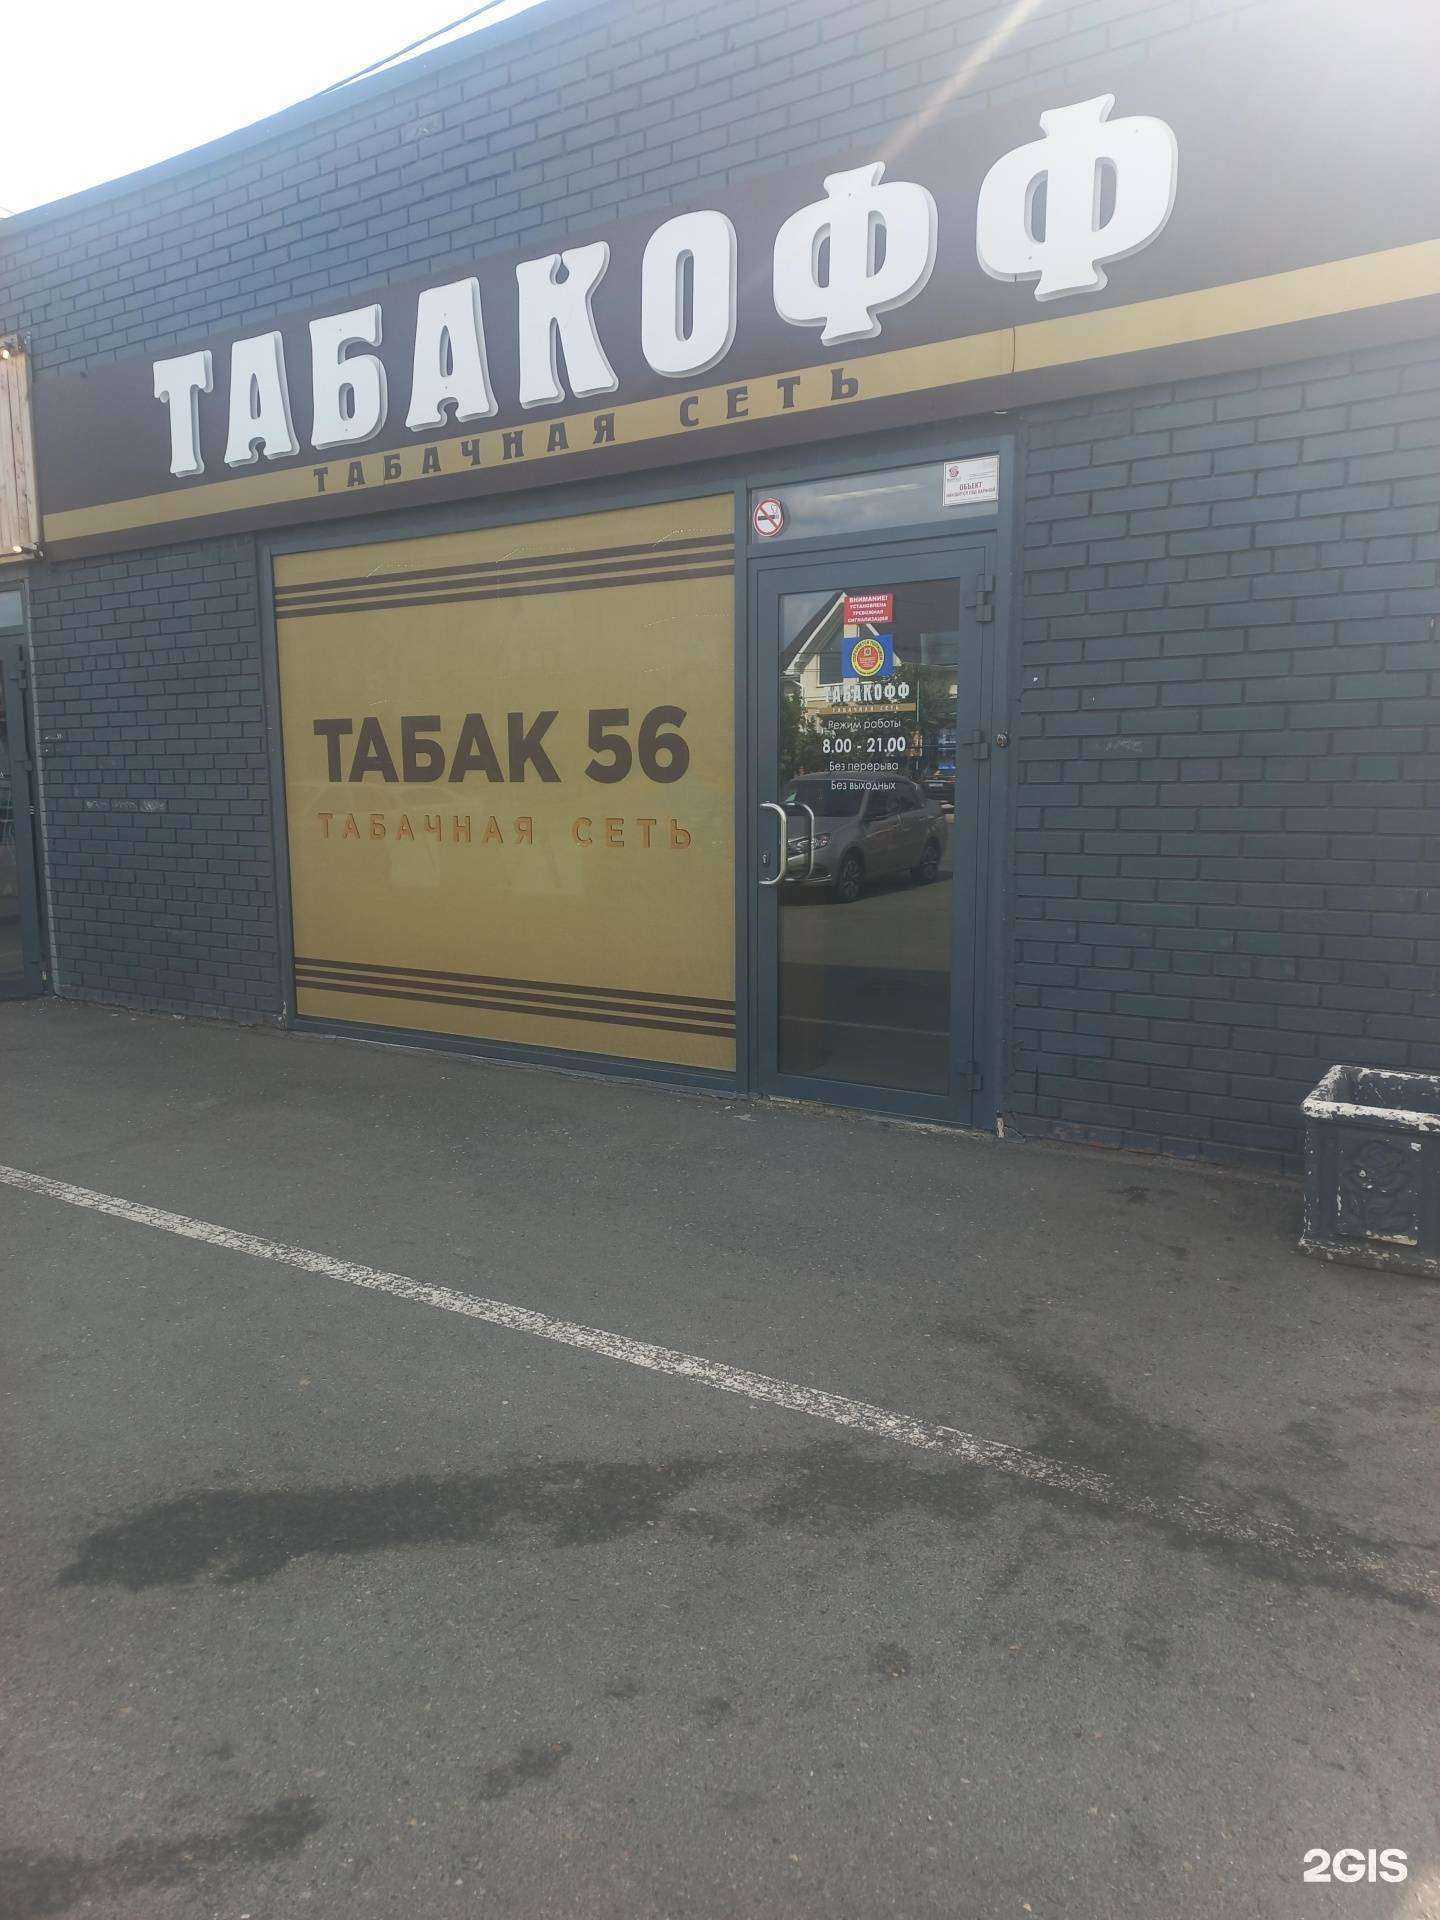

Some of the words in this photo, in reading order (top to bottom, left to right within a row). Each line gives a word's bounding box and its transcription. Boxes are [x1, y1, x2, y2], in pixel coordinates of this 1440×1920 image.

[153, 93, 1178, 478] ТАБАКОФФ
[313, 413, 615, 492] ТАБАЧНАЯ
[679, 368, 859, 428] СЕТЬ
[849, 595, 888, 603] ВНИМАНИЕ!
[825, 681, 910, 703] ТАБАКОФФ
[828, 720, 861, 730] Режим
[864, 718, 902, 732] работы
[313, 711, 562, 783] ТАБАК
[584, 705, 690, 784] 56
[822, 738, 852, 754] 8.00
[866, 736, 906, 753] 21.00
[829, 761, 845, 771] Без
[848, 762, 899, 774] перерыва
[831, 780, 847, 790] Без
[849, 781, 896, 793] выходных
[317, 812, 535, 846] ТАБАЧНАЯ
[571, 816, 692, 850] СЕТЬ
